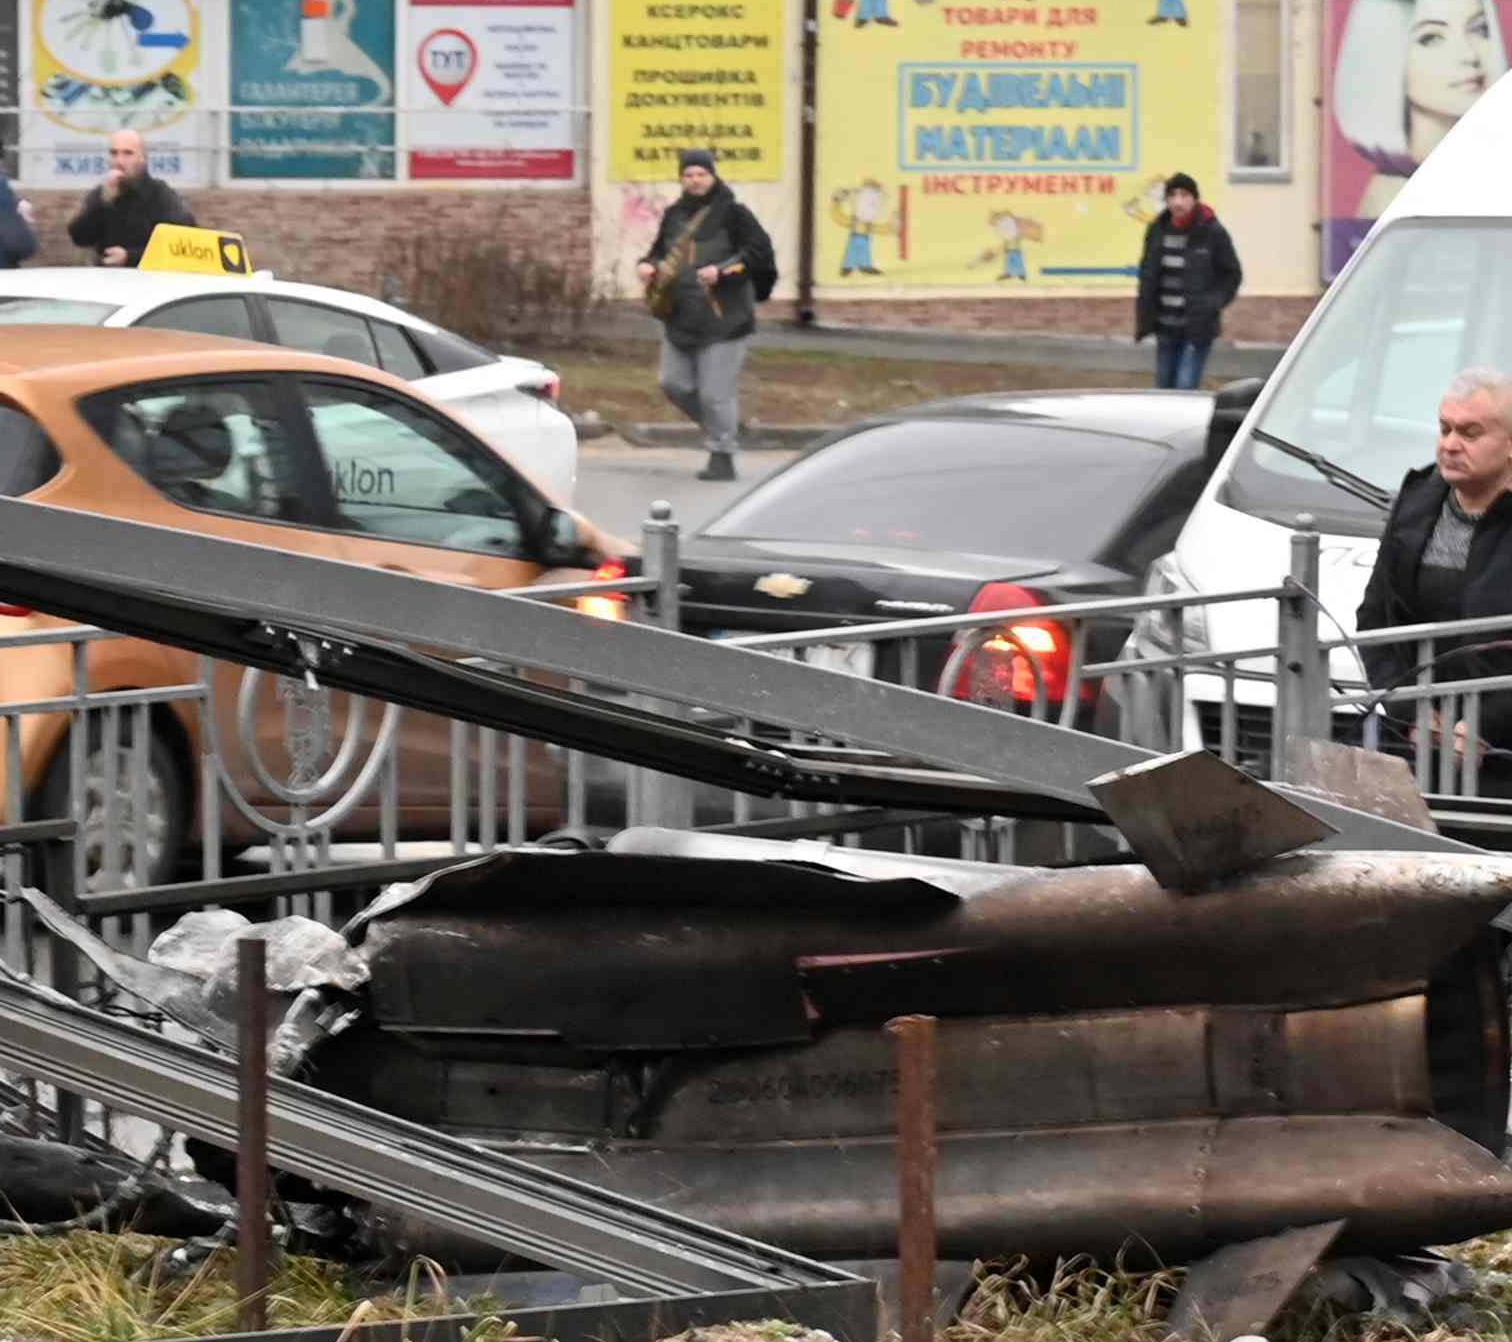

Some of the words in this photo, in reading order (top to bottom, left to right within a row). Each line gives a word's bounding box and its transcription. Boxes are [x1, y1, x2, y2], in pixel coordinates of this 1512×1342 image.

[646, 4, 746, 20] КСЕРОКС
[943, 7, 1038, 26] ТОВАРИ
[1045, 7, 1097, 28] ДЛЯ
[621, 33, 769, 51] КАНЦТОВАРИ
[960, 39, 1077, 59] РЕМОНТУ
[633, 70, 758, 85] ПРОШИВКА
[625, 92, 766, 109] ДОКУМЕНТІВ
[911, 71, 1127, 114] БУДІВЕЛЬНІ
[641, 123, 754, 140] ЗАПРАВКА
[915, 124, 1122, 161] МАТЕРІАЛИ
[55, 155, 183, 175] ЖИВНЯ
[921, 175, 1116, 194] ІНСТРУМЕНТИ
[169, 238, 215, 261] uklon
